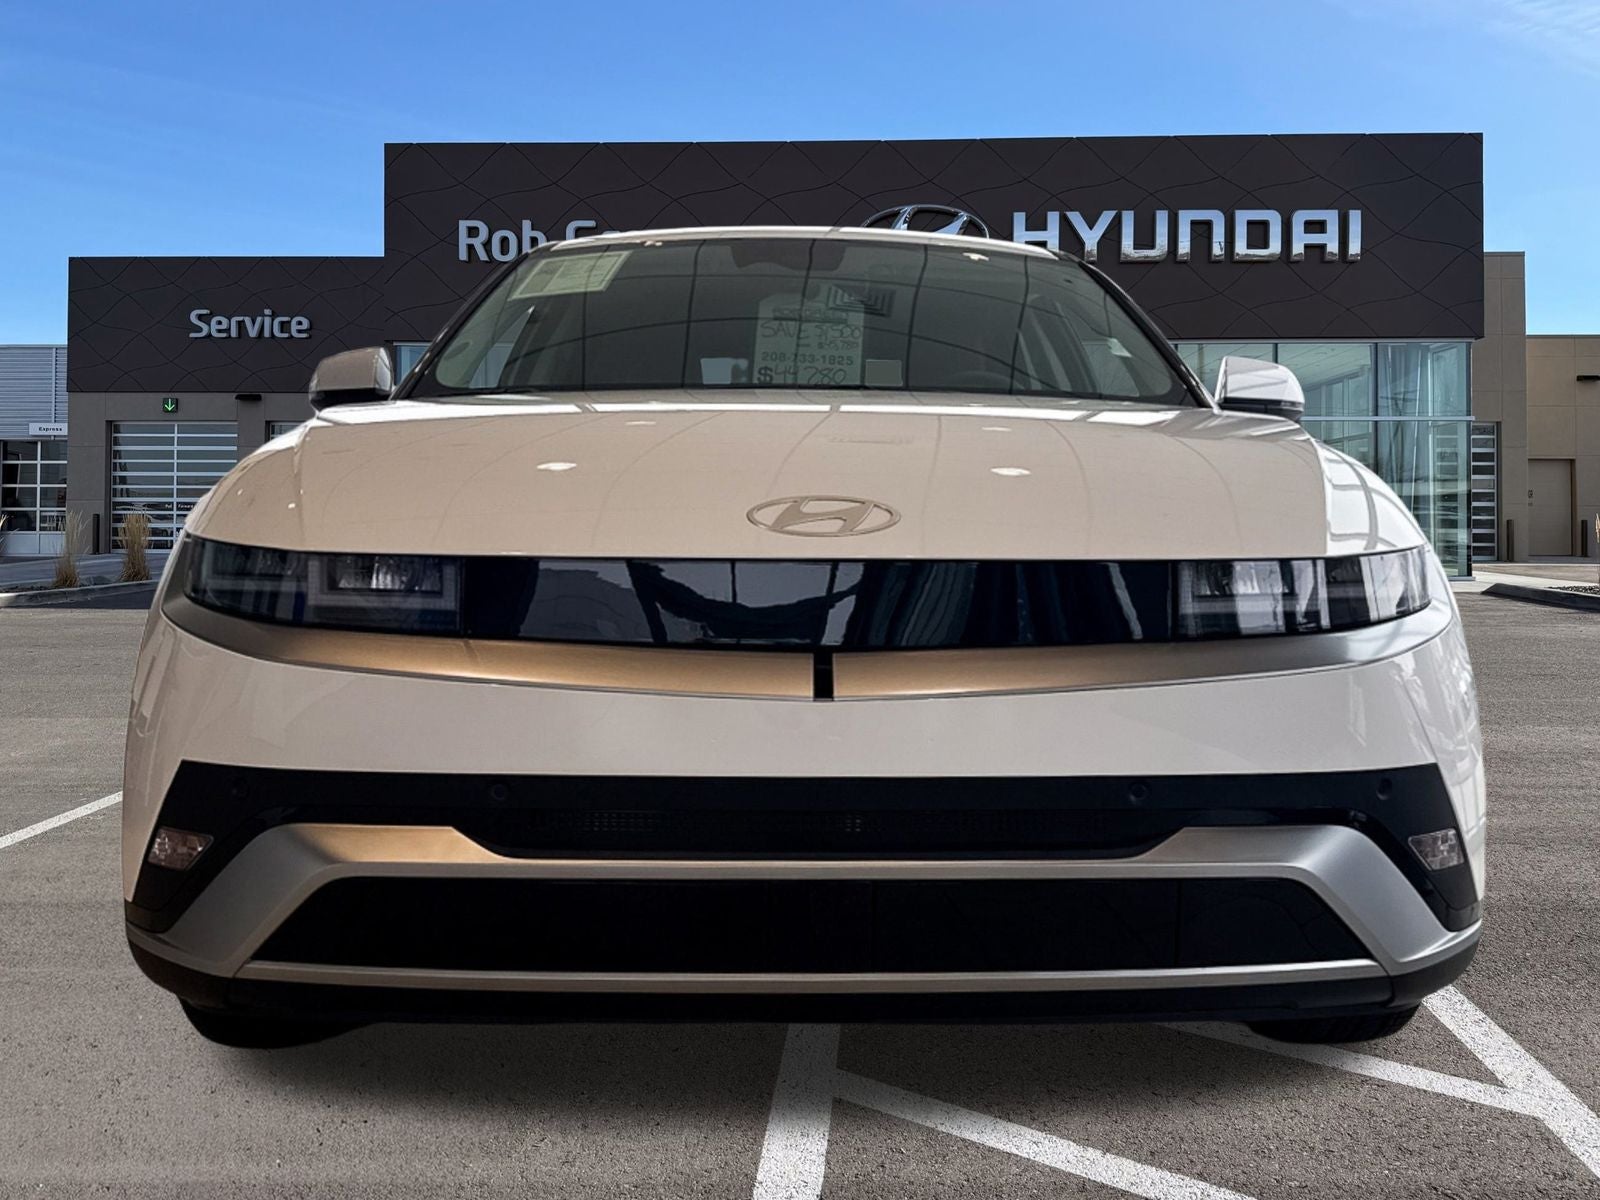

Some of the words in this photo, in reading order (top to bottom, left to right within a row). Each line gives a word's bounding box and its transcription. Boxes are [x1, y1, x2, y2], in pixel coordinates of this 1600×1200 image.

[458, 220, 547, 262] Rob
[1012, 209, 1363, 262] HYUNDAI
[188, 308, 311, 338] Service
